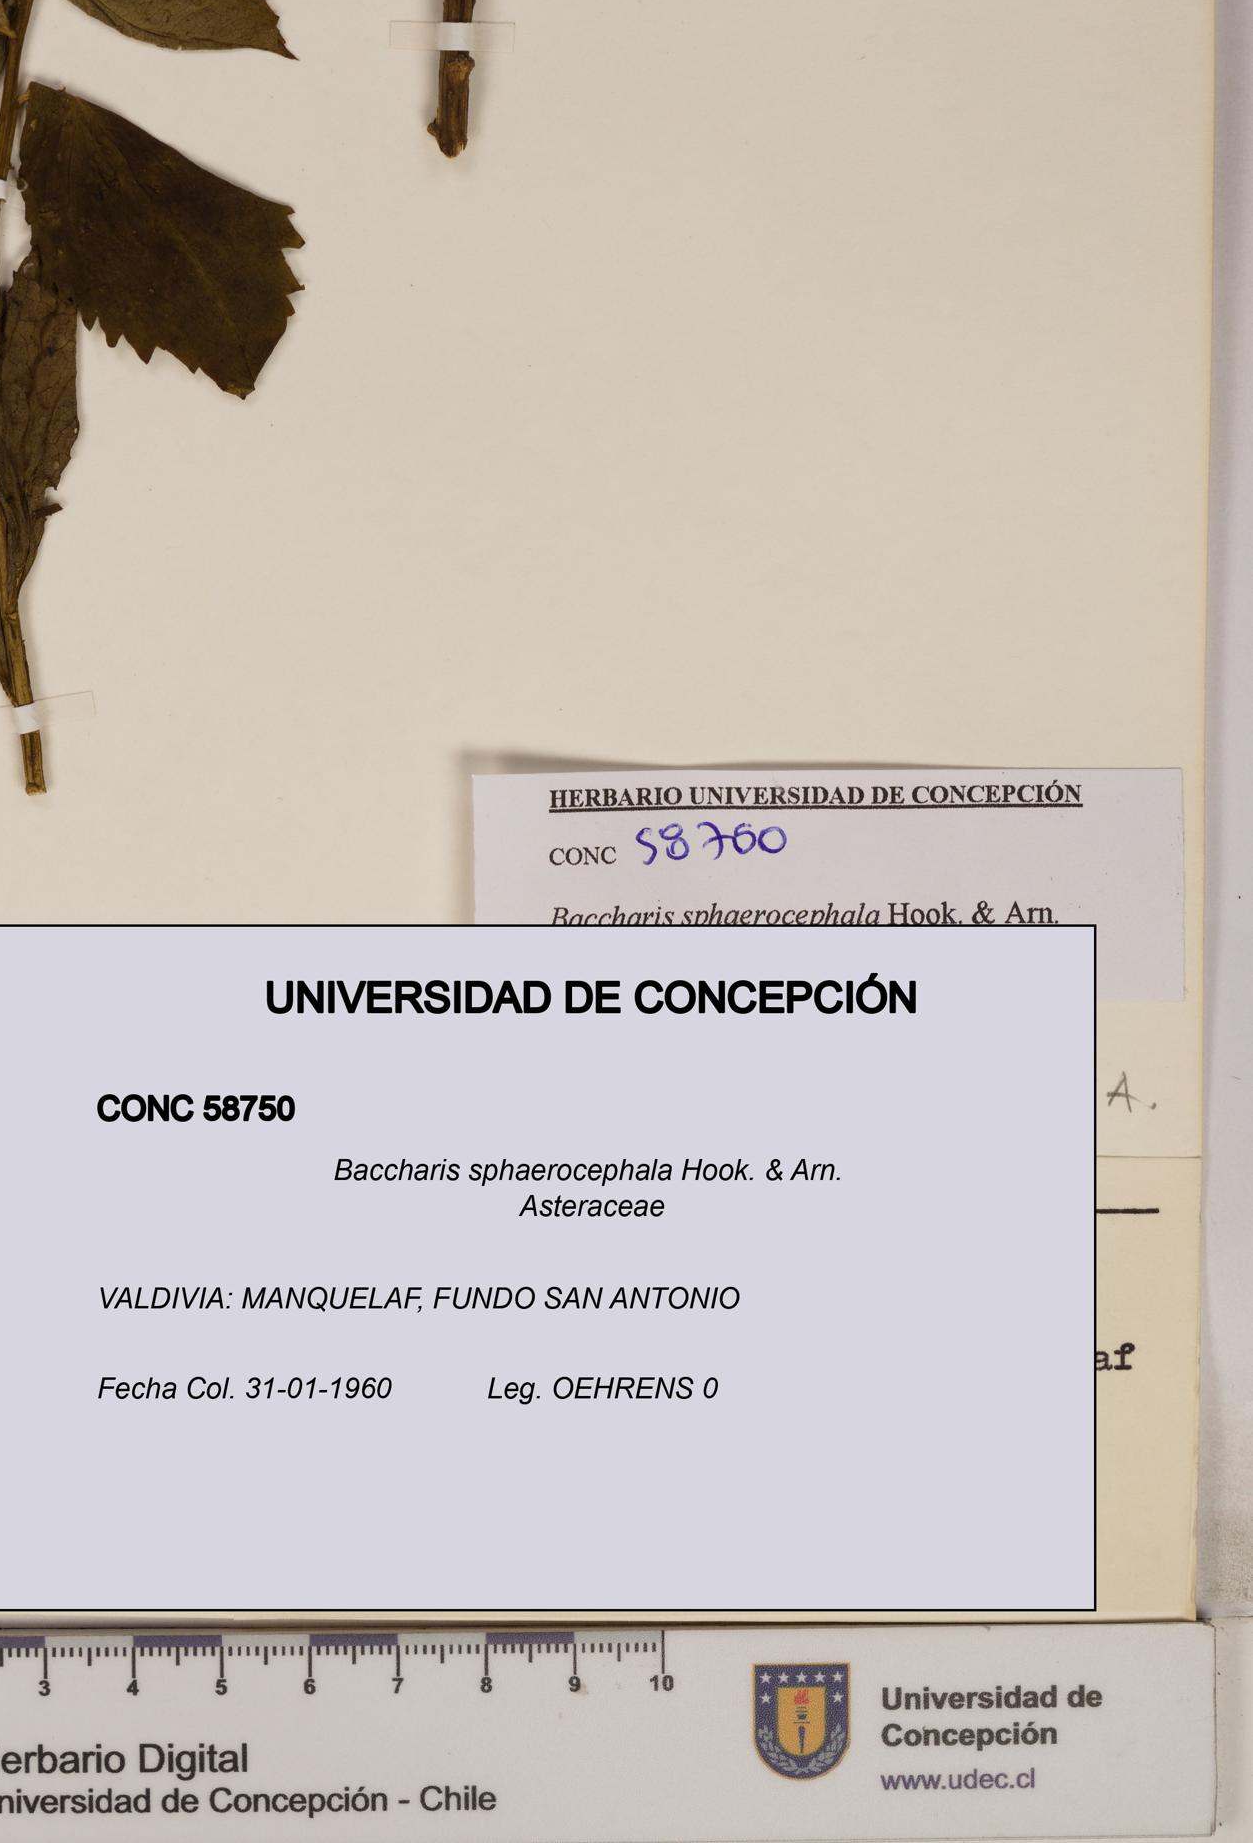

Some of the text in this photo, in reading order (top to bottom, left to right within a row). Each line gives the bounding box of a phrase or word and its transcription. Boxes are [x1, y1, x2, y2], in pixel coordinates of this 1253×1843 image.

[549, 779, 1082, 808] HERBARIO UNIVERSIDAD DE CONCEPCIÓN
[548, 845, 617, 866] CONC
[887, 900, 963, 924] Hook.
[971, 900, 996, 924] &
[1004, 900, 1059, 924] Arn.
[38, 1679, 51, 1697] 3
[126, 1678, 140, 1697] 4
[214, 1677, 228, 1696] 5
[303, 1677, 317, 1695] 6
[391, 1676, 405, 1695] 7
[480, 1676, 493, 1694] 8
[567, 1675, 582, 1693] 9
[649, 1674, 675, 1692] 10
[881, 1684, 1103, 1711] Universidad de
[880, 1721, 1058, 1752] Concepción
[138, 1742, 248, 1782] Digital
[880, 1767, 1036, 1791] www.udec.cl
[161, 1787, 200, 1814] de
[208, 1785, 388, 1819] Concepción
[419, 1784, 497, 1812] Chile
